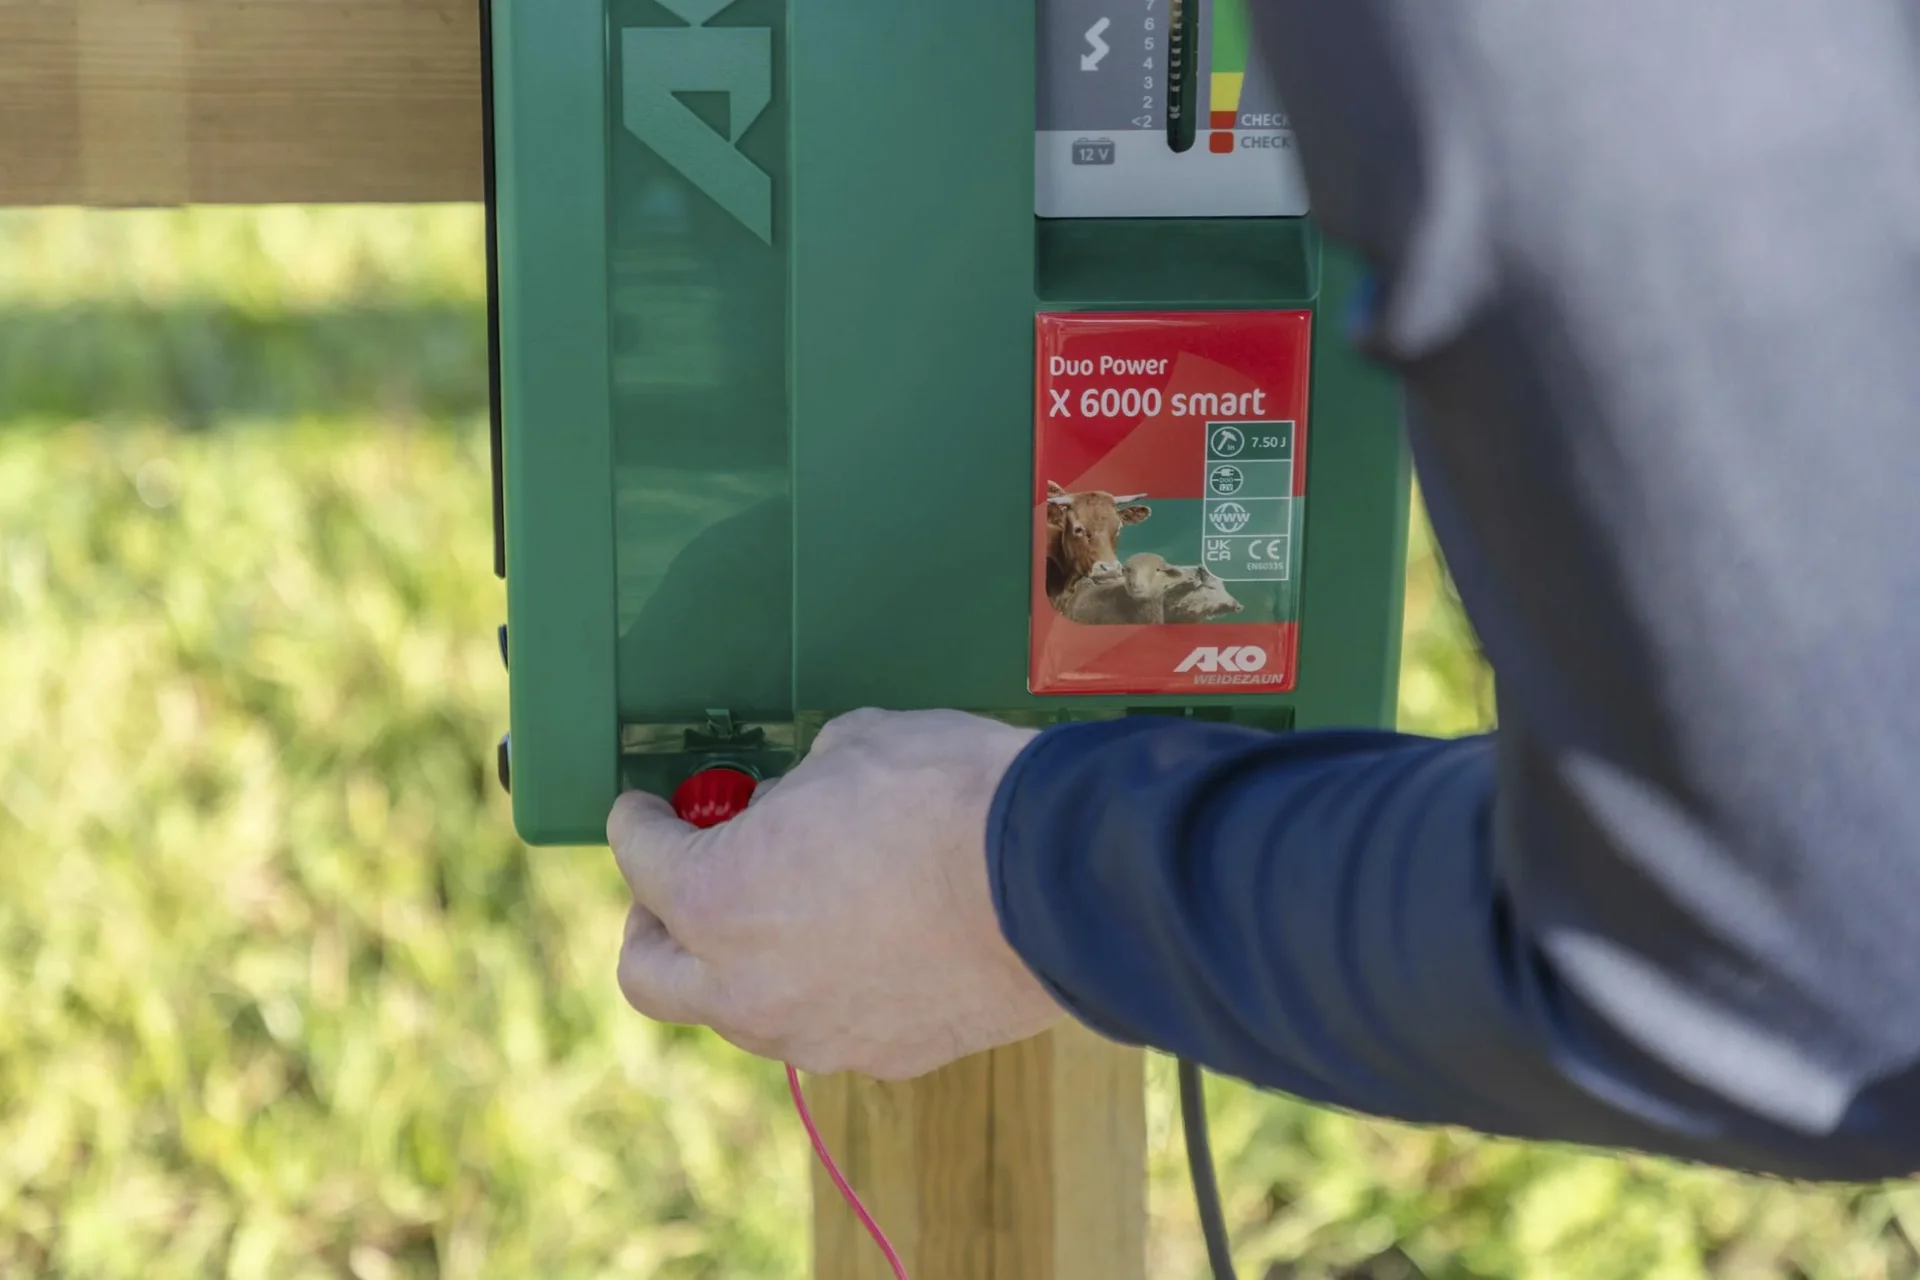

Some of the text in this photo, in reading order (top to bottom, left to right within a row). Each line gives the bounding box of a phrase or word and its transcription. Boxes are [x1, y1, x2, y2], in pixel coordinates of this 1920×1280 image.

[1144, 17, 1155, 31] 6
[1144, 37, 1155, 50] 5
[1143, 57, 1154, 70] 4
[1143, 76, 1153, 90] 3
[1143, 95, 1153, 109] 2
[1131, 115, 1152, 128] <2
[1079, 148, 1110, 161] 12 V
[1050, 355, 1168, 376] Duo Power
[1049, 388, 1266, 417] X 6000 smart
[1251, 436, 1287, 448] 7.50 J
[1207, 540, 1232, 550] UK
[1248, 539, 1281, 560] CE
[1207, 551, 1231, 561] CA
[1173, 645, 1267, 673] AKO
[1193, 674, 1284, 685] WEIDEZAUN
